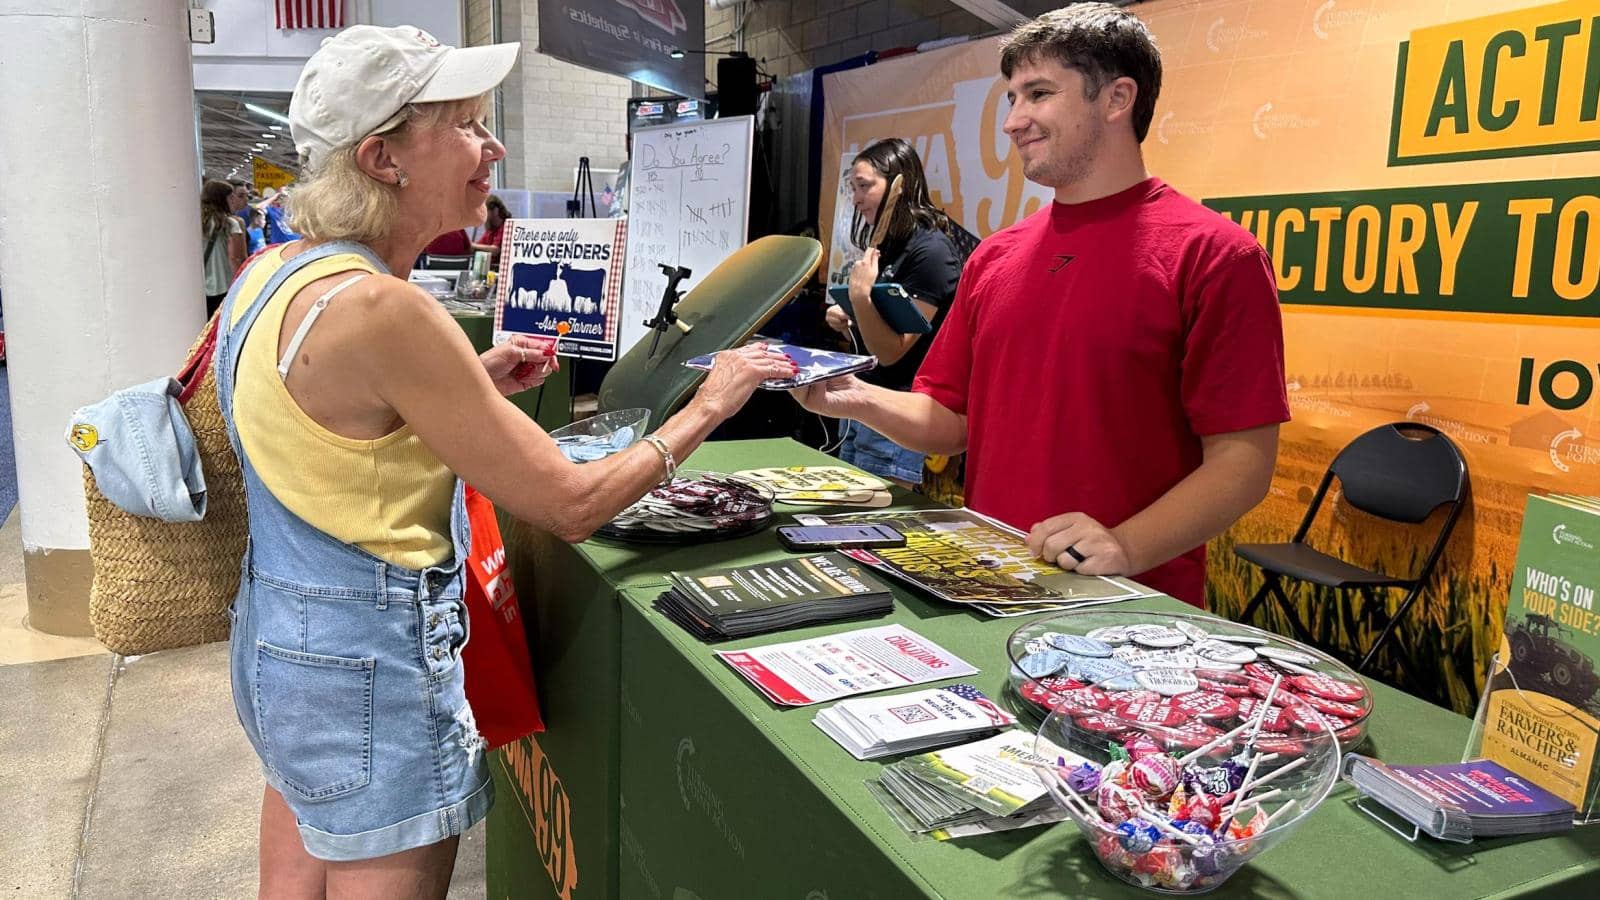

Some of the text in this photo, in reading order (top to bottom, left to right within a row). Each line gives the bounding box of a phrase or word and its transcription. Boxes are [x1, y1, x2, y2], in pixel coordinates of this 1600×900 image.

[669, 145, 685, 168] You
[690, 143, 731, 170] Agree?
[514, 226, 579, 247] There are only
[513, 243, 611, 260] TWO GENDERS
[566, 317, 604, 335] Farmer
[1516, 357, 1600, 411] IO
[807, 555, 827, 569] WE
[1526, 567, 1595, 610] WHO'S ON
[1523, 587, 1600, 637] YOUR SIDE?
[884, 634, 949, 670] COALITIONS
[922, 697, 959, 722] REGISTER
[936, 692, 977, 720] SCAN HERE
[943, 702, 955, 713] TO
[1499, 704, 1578, 754] FARMERS &
[1496, 718, 1578, 769] RANCHERS
[1510, 747, 1549, 771] ALMANAC
